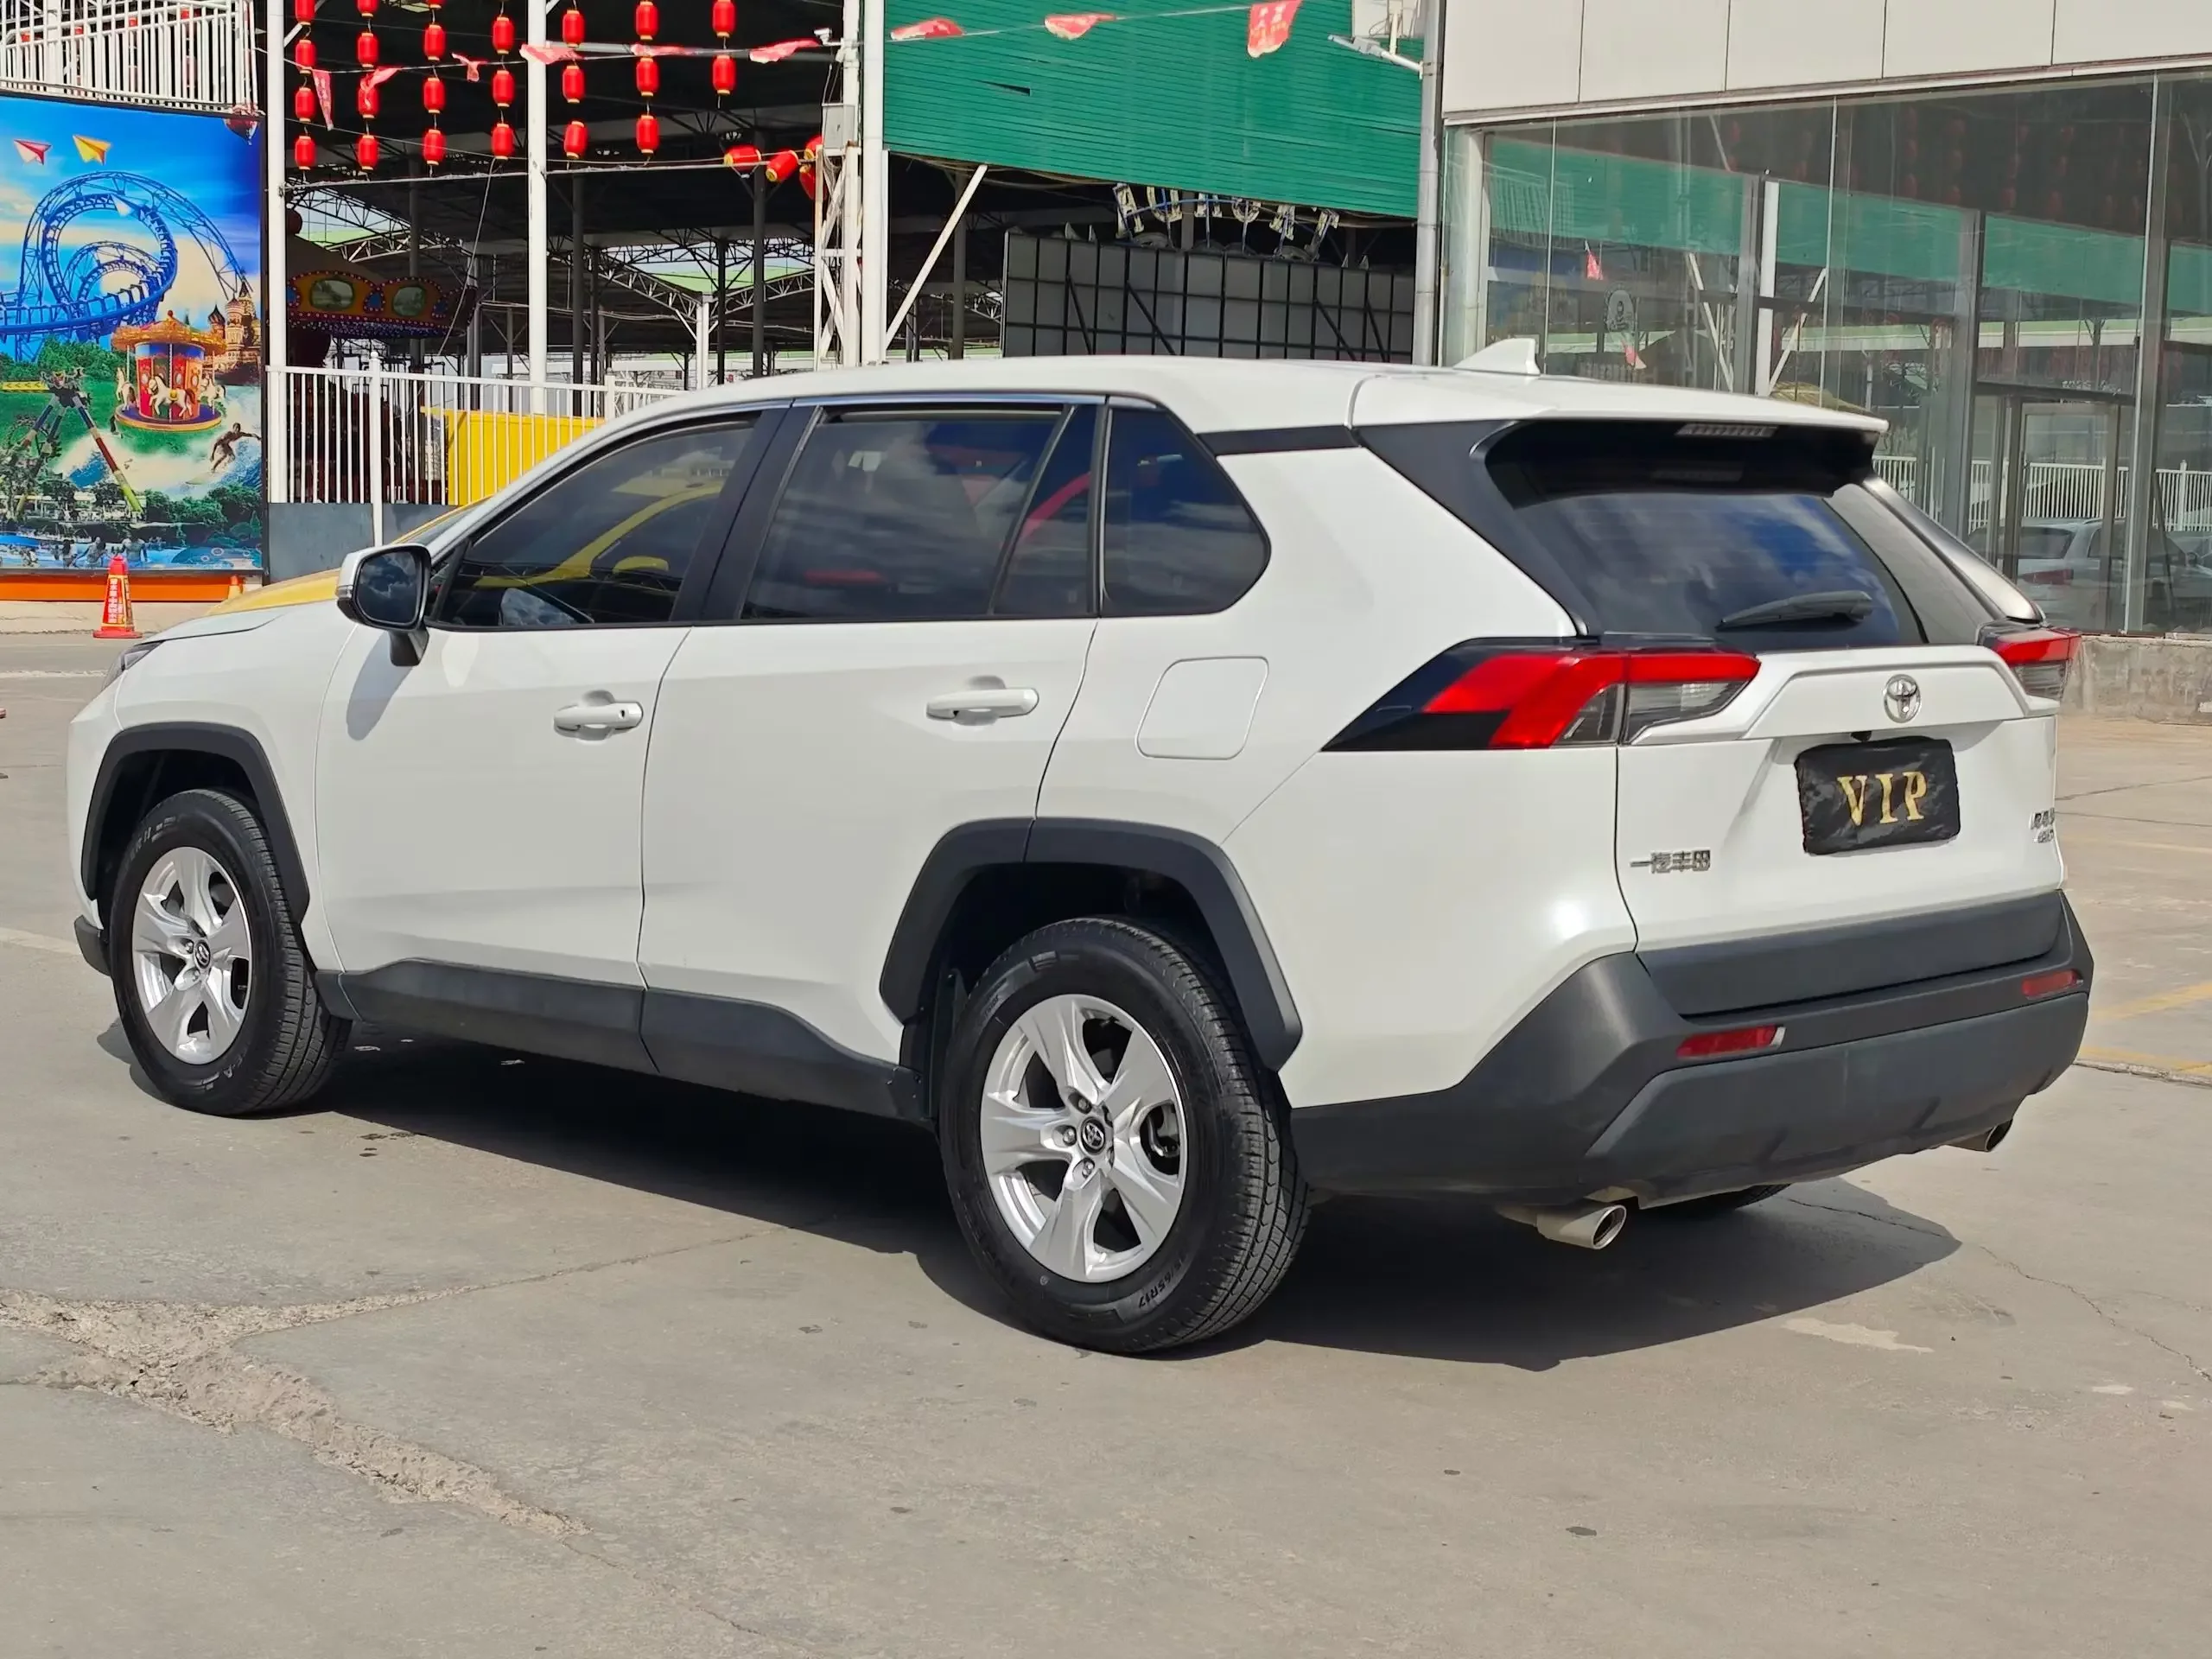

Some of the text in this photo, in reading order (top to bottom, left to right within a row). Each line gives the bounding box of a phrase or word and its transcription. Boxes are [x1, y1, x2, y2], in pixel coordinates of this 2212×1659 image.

[1836, 771, 1928, 827] VIP
[1629, 849, 1711, 874] 一汽丰田
